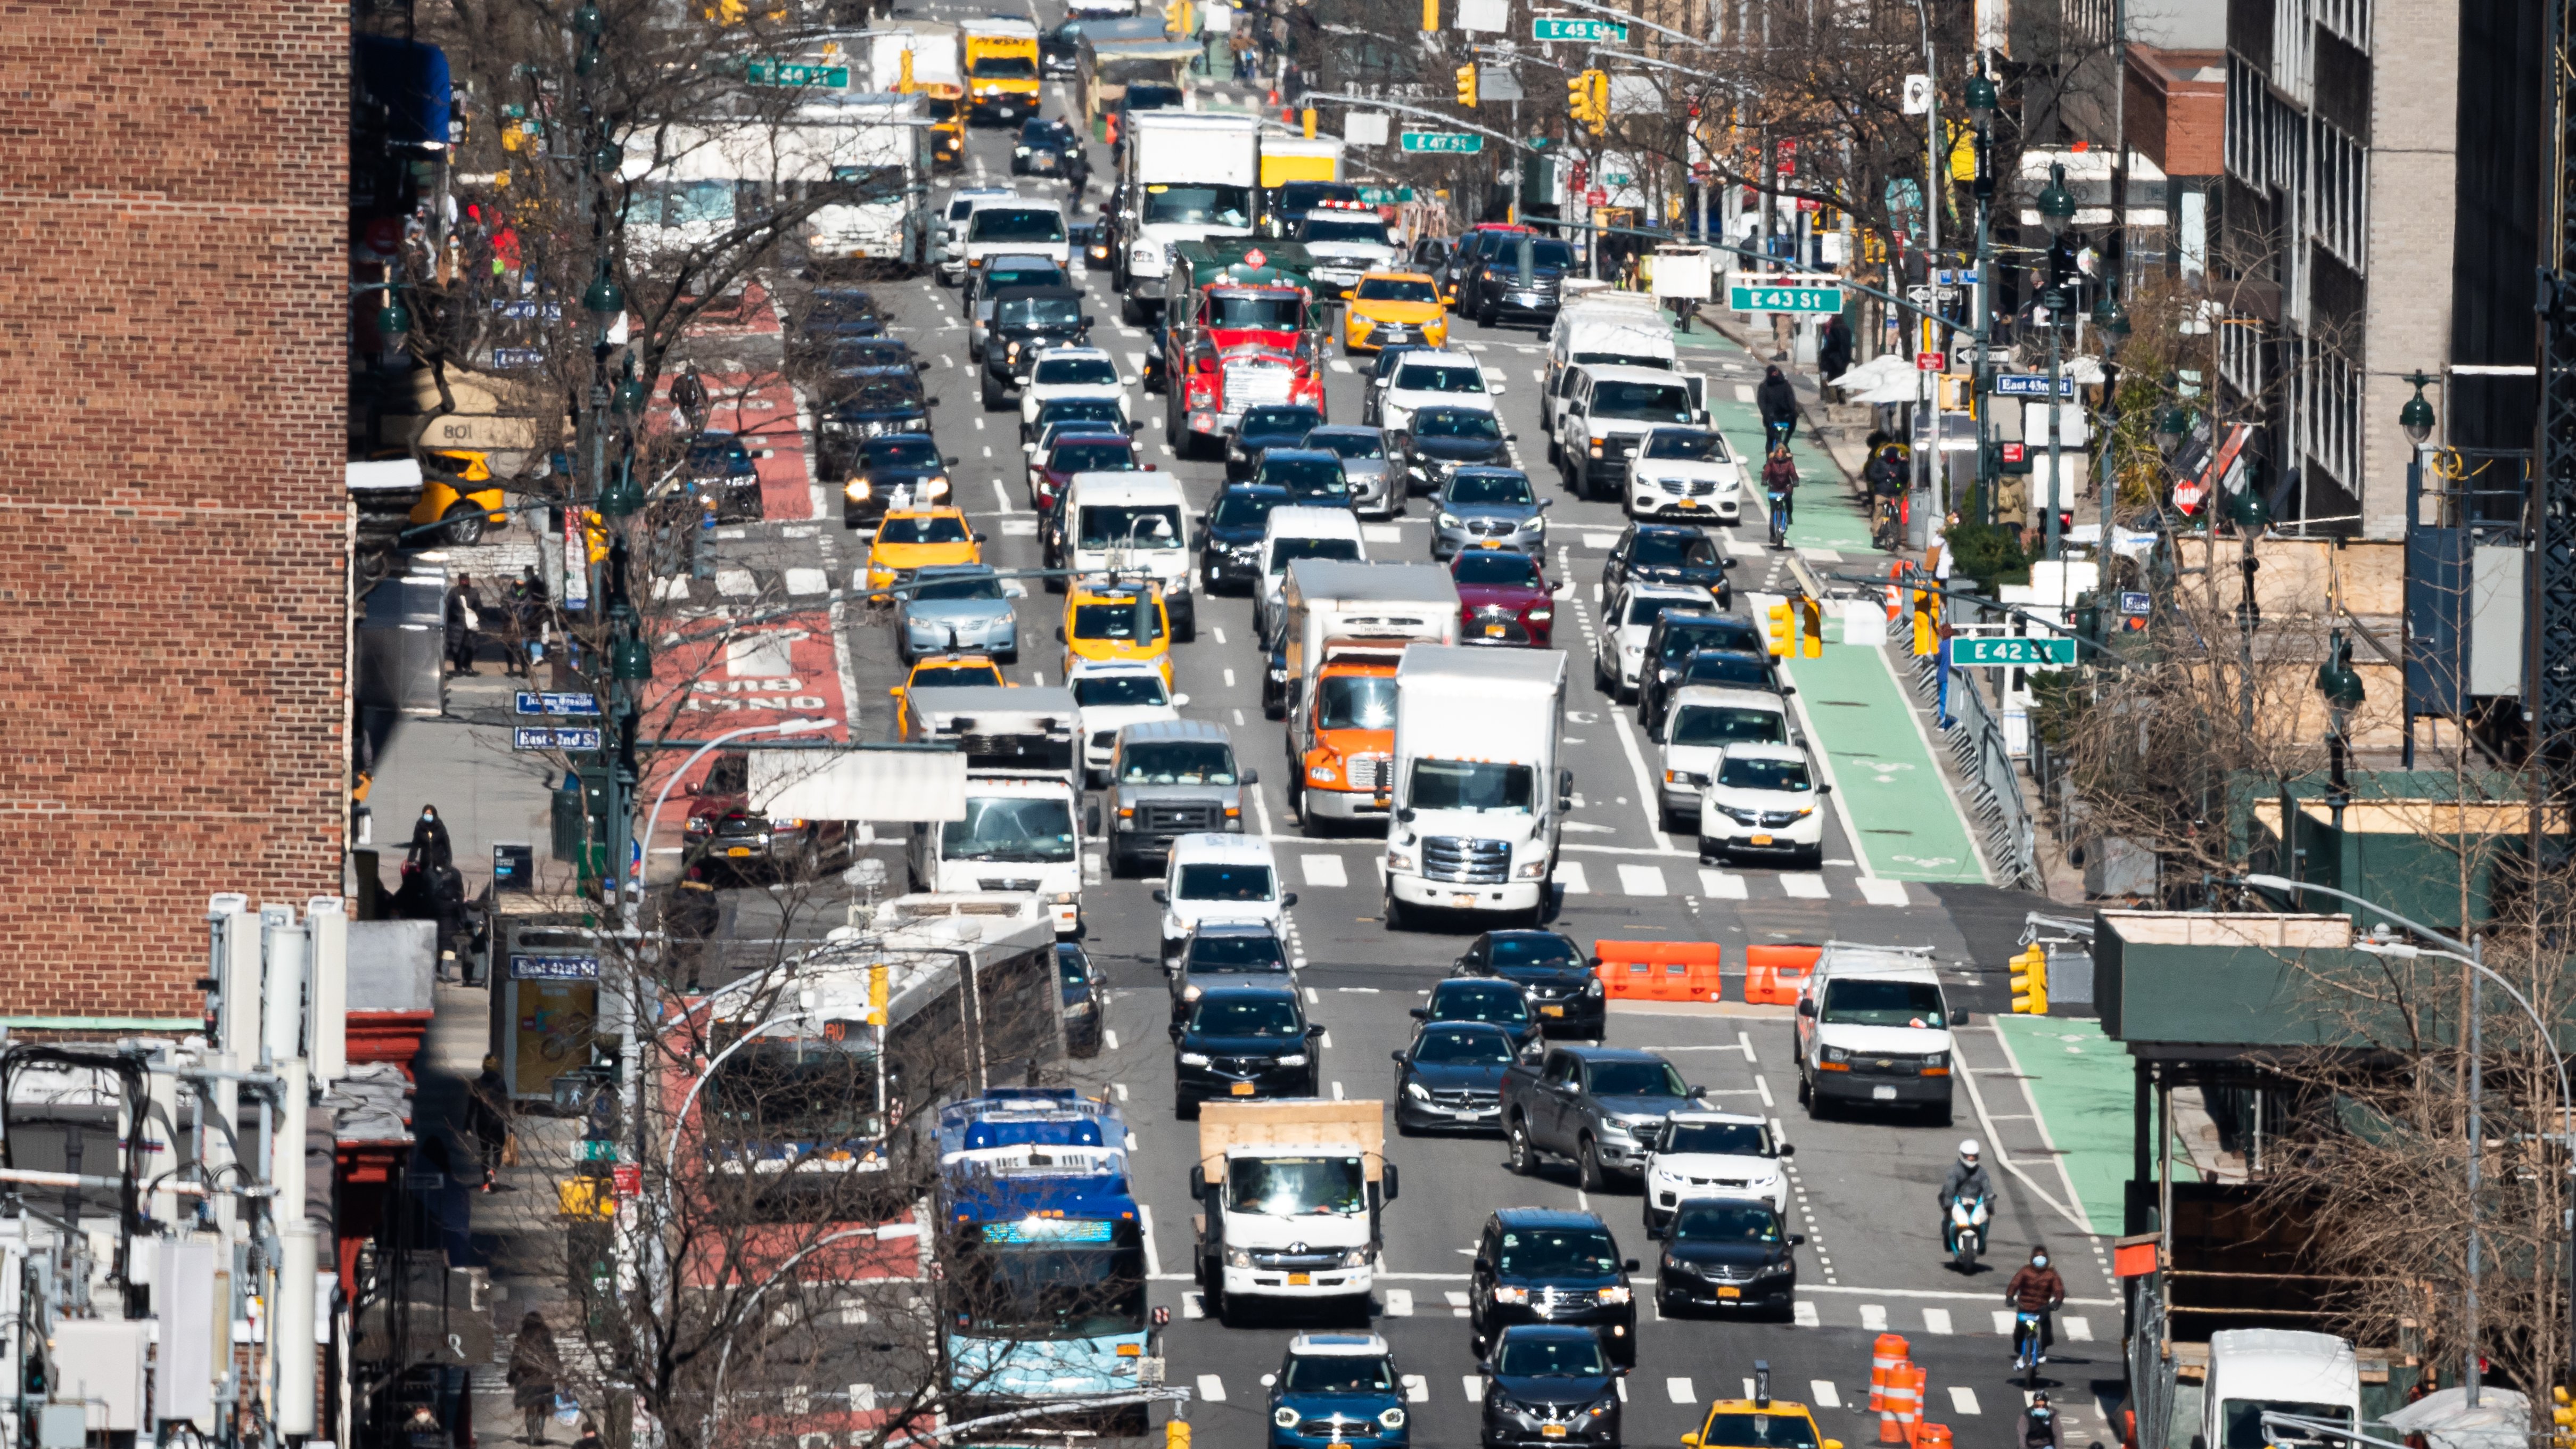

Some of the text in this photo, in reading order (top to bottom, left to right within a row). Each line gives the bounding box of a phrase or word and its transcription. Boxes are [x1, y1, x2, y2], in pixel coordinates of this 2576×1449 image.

[1551, 22, 1560, 36] E
[1565, 23, 1586, 37] 45
[1417, 136, 1425, 149] E
[1429, 137, 1447, 149] 47
[1751, 291, 1821, 308] E 43 St
[2002, 378, 2026, 390] East
[444, 425, 472, 439] 801
[1975, 643, 2052, 660] E 42 St
[520, 731, 547, 745] East
[518, 960, 546, 974] East
[580, 961, 596, 976] St
[826, 1023, 845, 1041] AV
